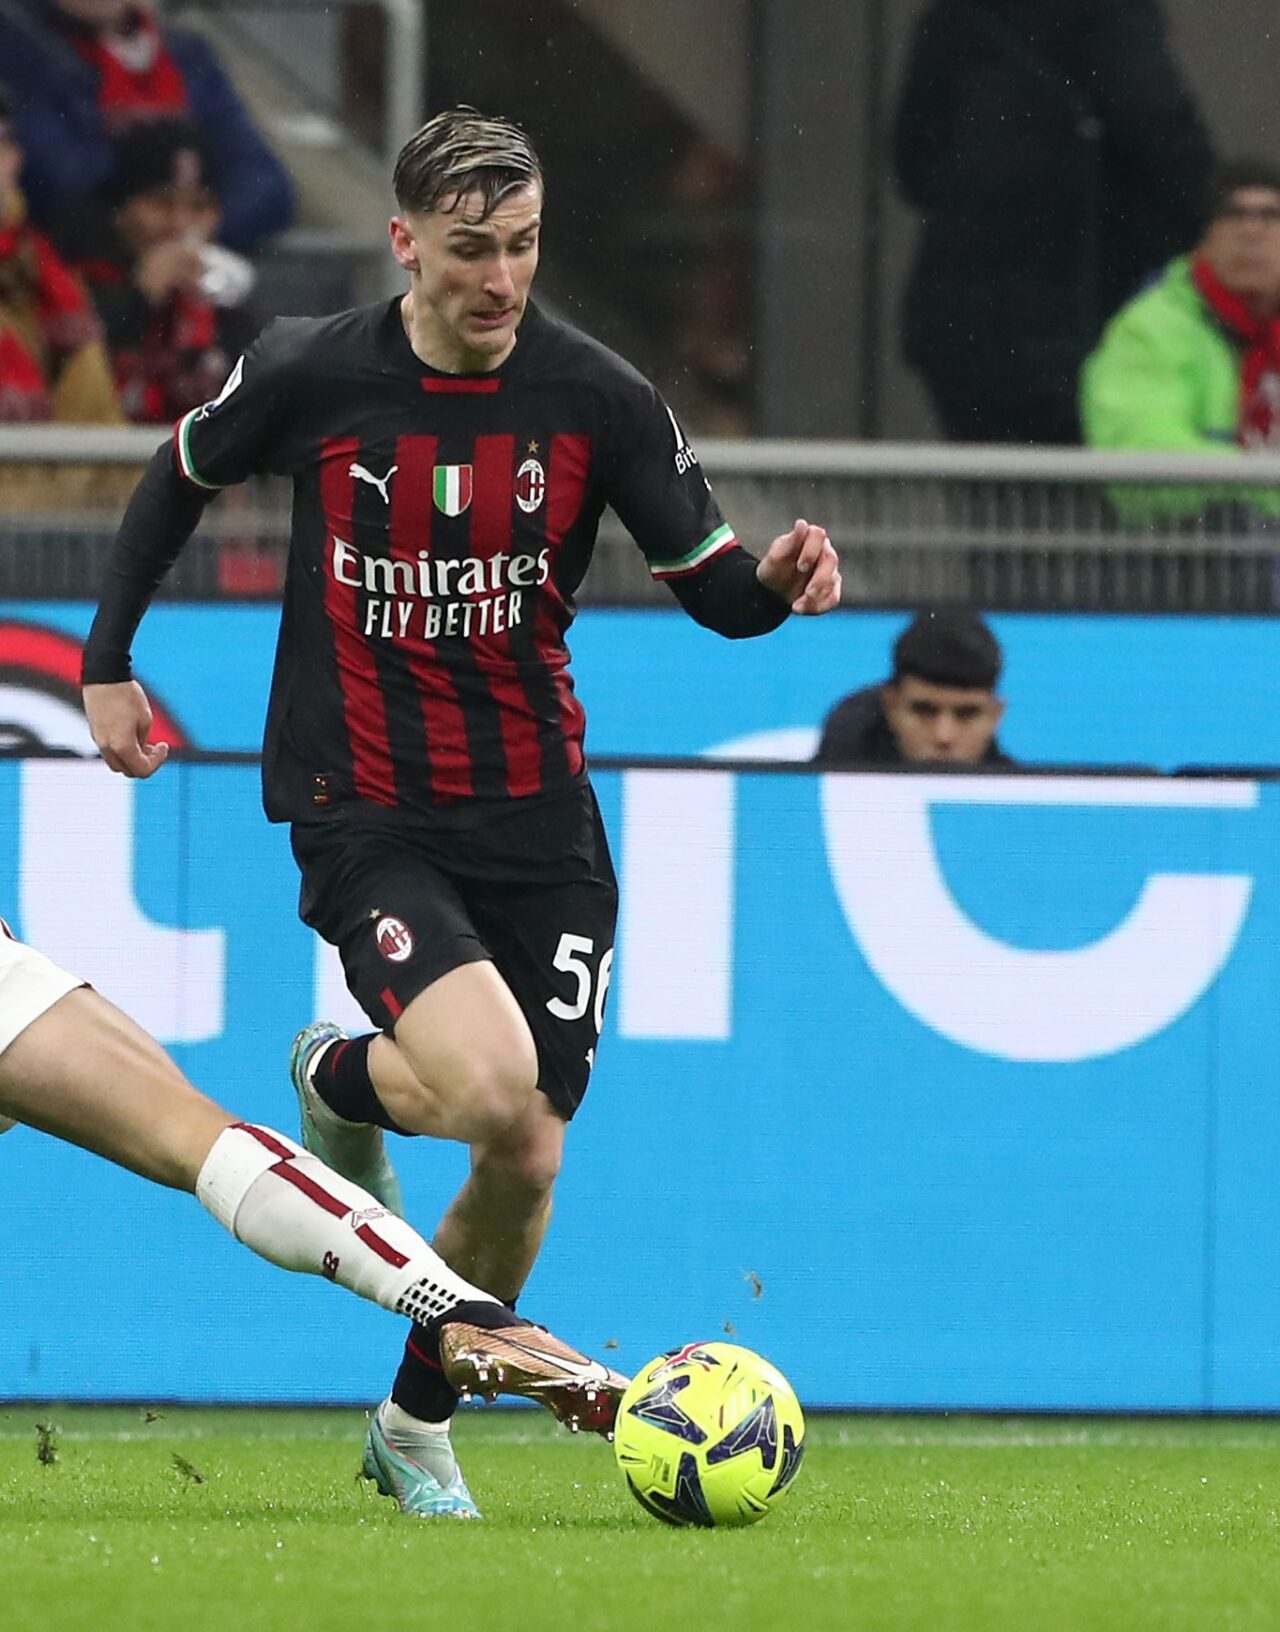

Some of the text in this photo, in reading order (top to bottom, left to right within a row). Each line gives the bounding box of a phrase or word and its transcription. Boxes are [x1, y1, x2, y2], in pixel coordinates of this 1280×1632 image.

[333, 535, 550, 598] Emirates
[364, 590, 523, 640] FLY BETTER
